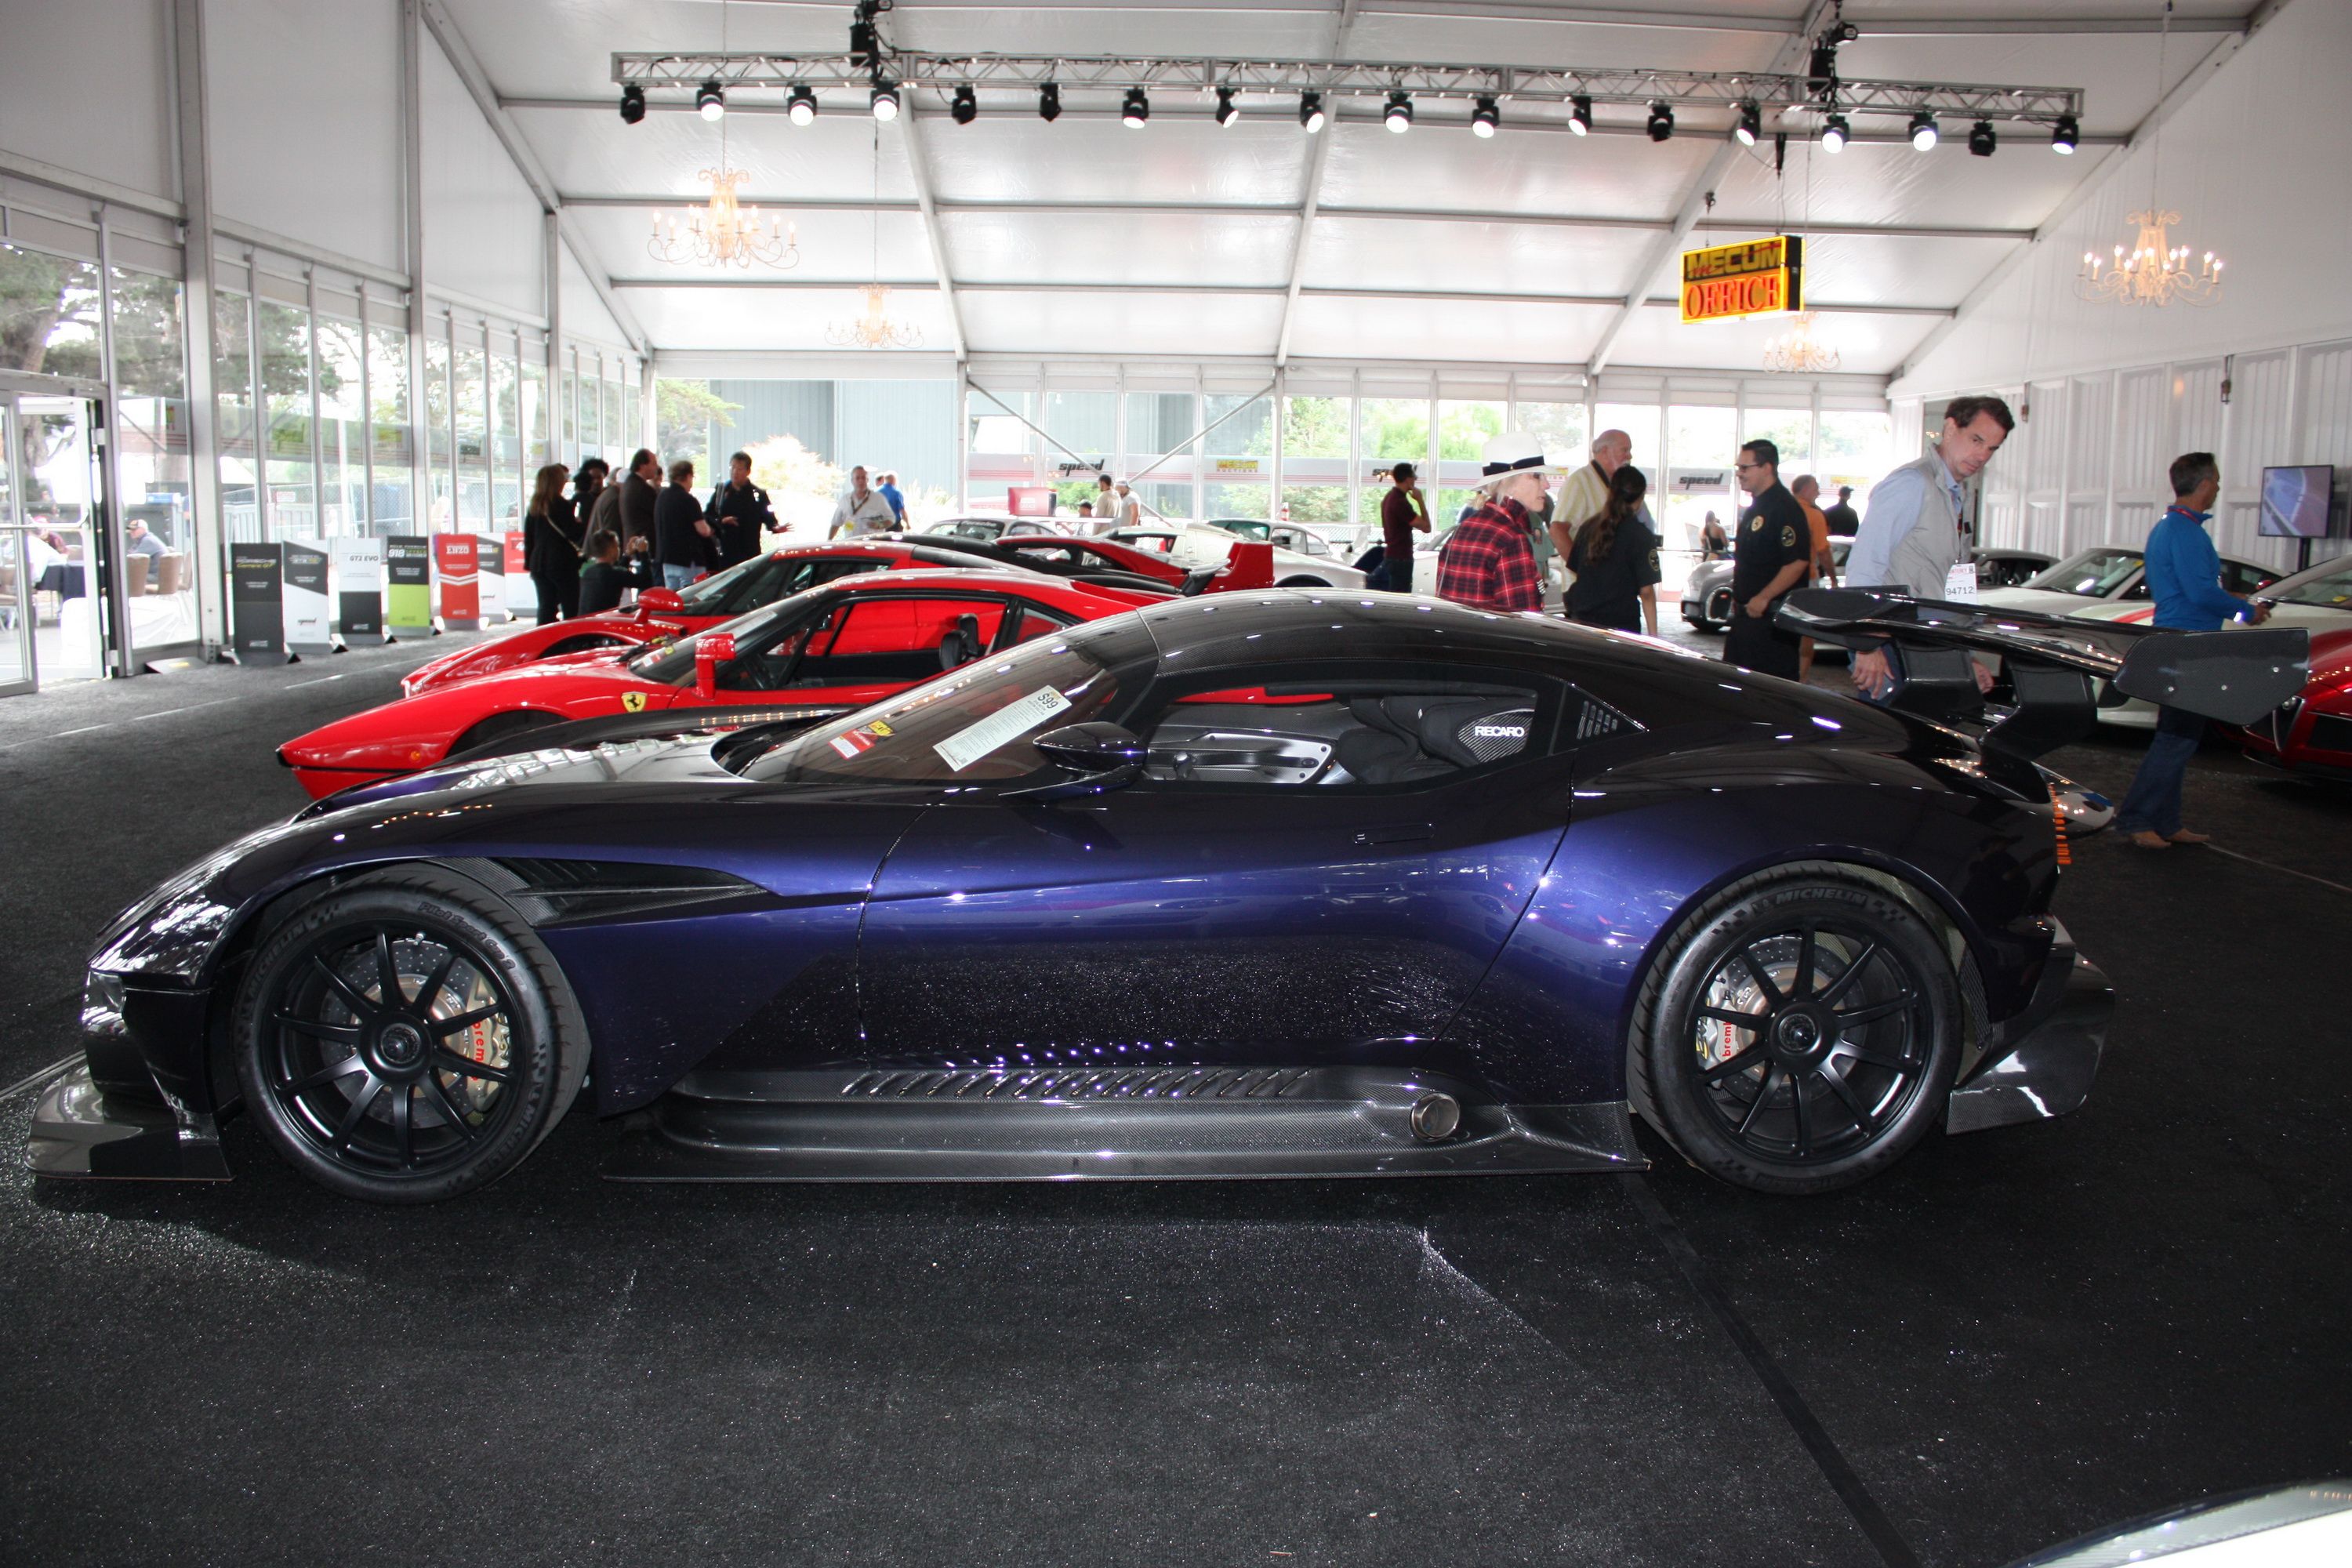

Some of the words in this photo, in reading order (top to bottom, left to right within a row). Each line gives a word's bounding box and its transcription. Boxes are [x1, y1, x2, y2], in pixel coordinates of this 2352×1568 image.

[1686, 241, 1781, 279] MECUM
[1686, 273, 1780, 318] OFFICE
[1058, 459, 1105, 477] speed
[1679, 473, 1723, 490] speed
[388, 548, 405, 557] 918
[446, 545, 470, 554] ENZO
[1946, 586, 1974, 596] 94712
[1037, 693, 1058, 709] S99
[1475, 726, 1525, 737] RECARO
[1776, 887, 1867, 905] MICHELIN
